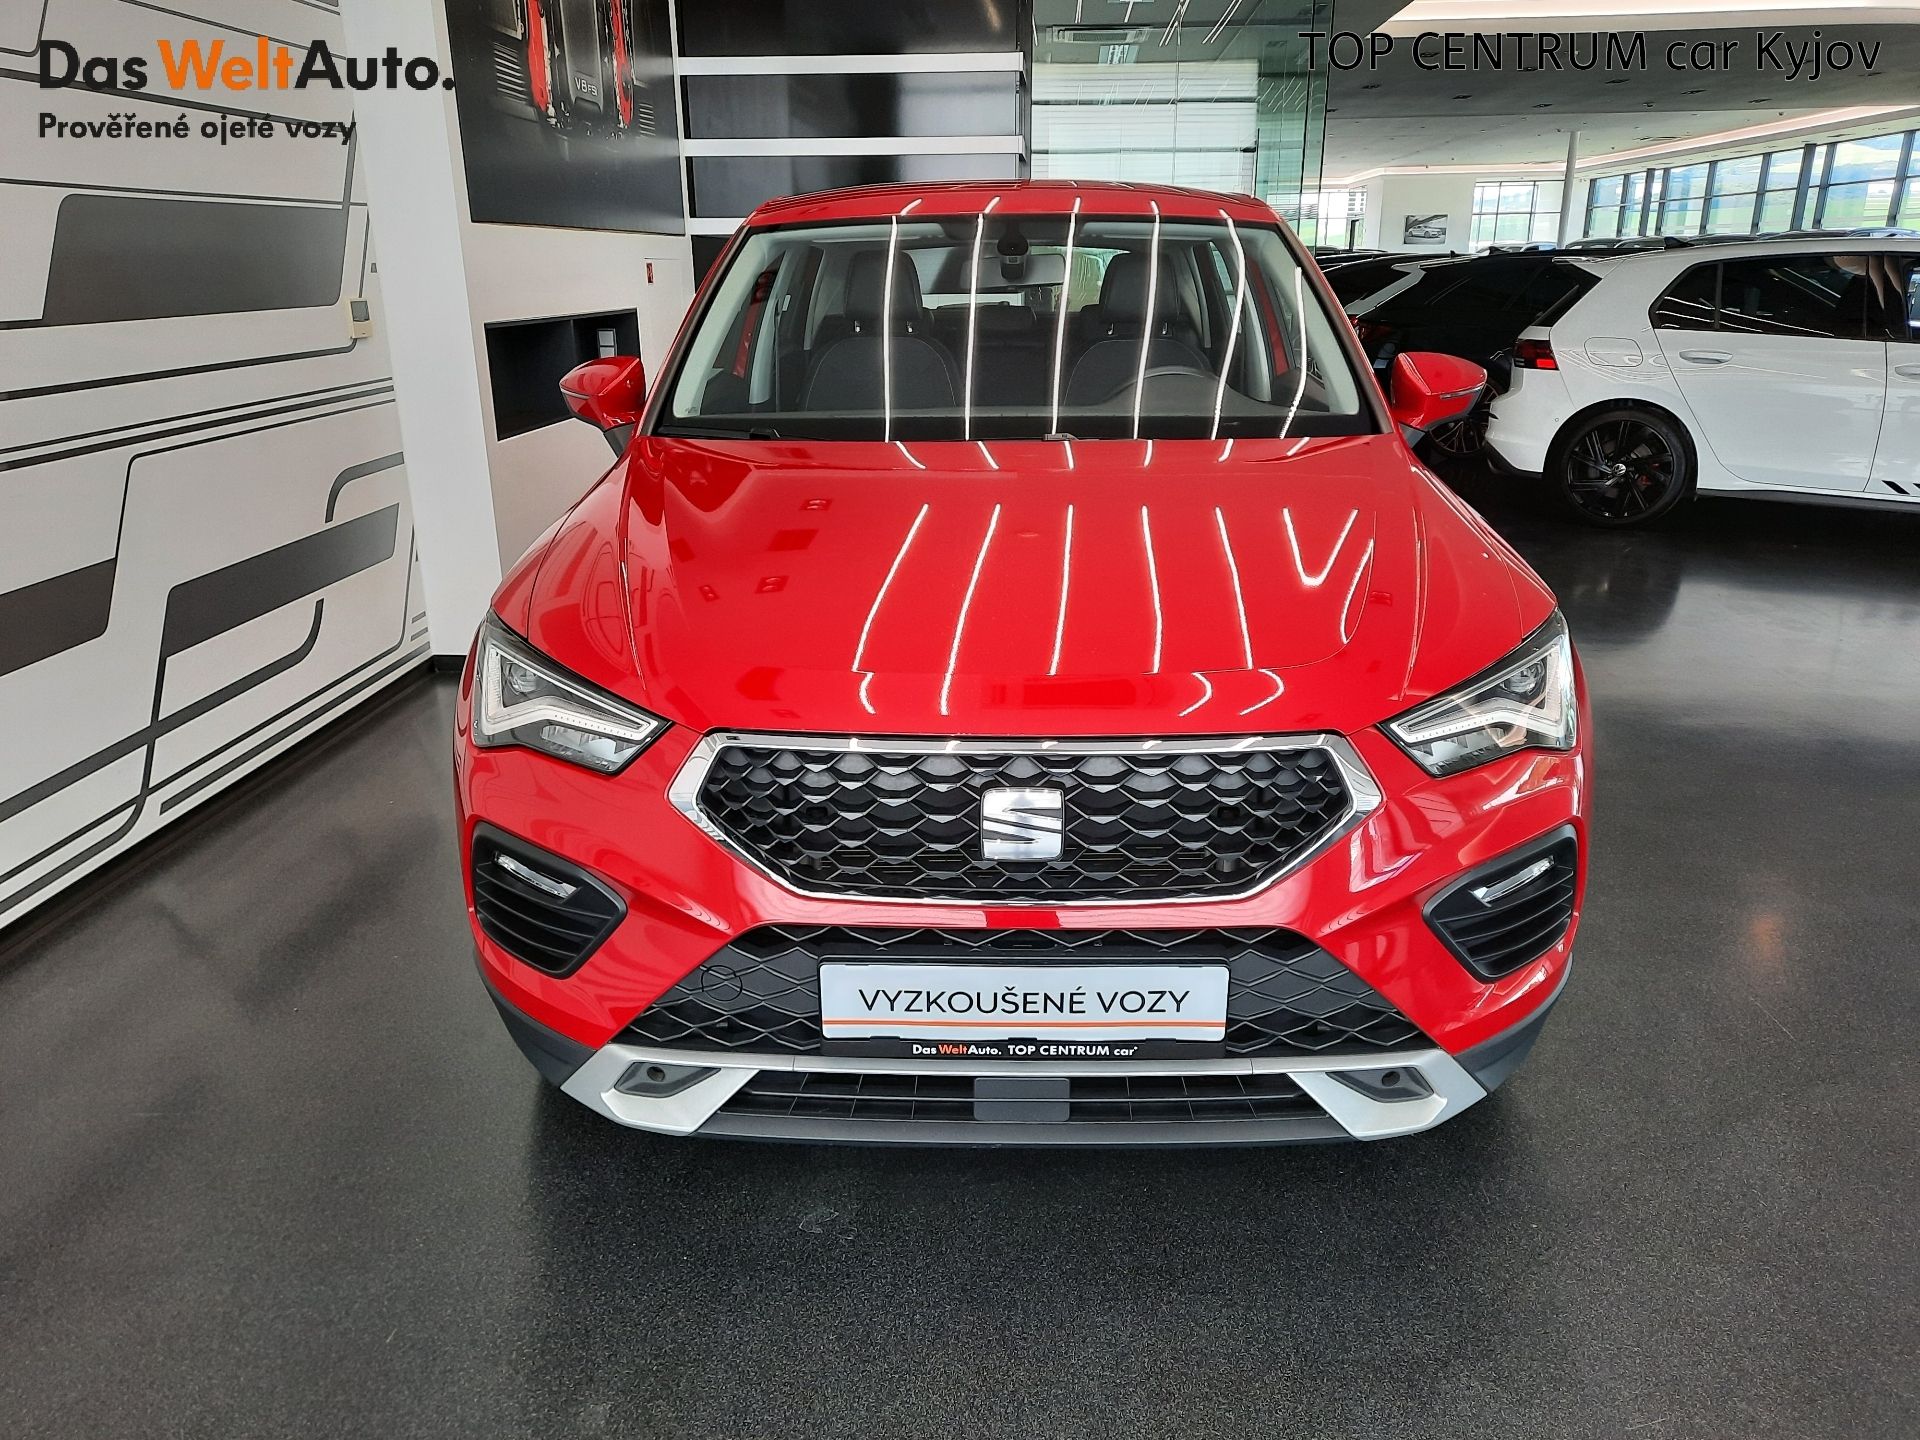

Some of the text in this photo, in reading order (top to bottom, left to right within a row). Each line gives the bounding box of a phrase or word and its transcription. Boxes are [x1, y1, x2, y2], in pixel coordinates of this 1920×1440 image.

[858, 986, 1191, 1014] VYZKOUŠENÉ VOZY
[912, 1044, 937, 1055] Das
[938, 1043, 1002, 1055] WeltAuto.
[1007, 1044, 1036, 1056] TOP
[1039, 1044, 1110, 1056] CENTRUM
